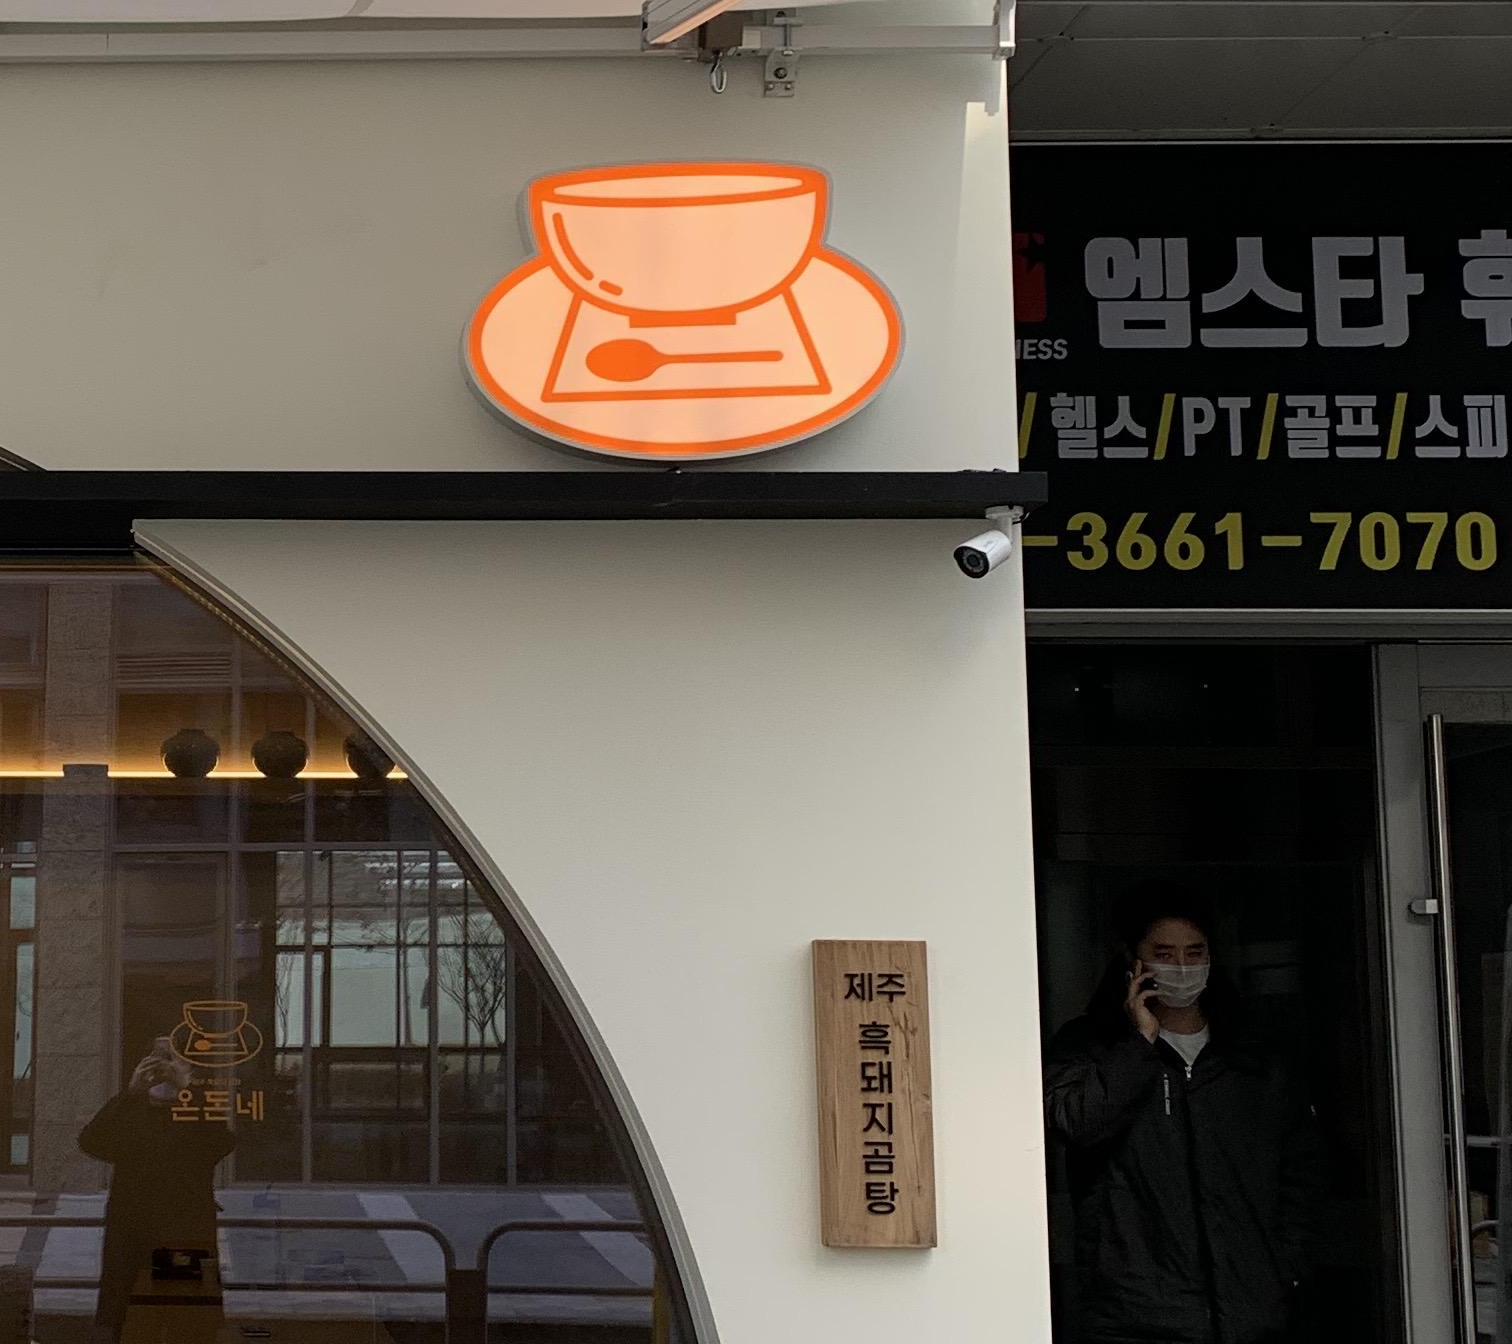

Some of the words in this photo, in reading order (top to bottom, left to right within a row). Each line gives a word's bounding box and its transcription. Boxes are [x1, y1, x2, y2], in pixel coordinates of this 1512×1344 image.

[1084, 236, 1425, 349] 엠스타
[844, 972, 907, 1003] 제주
[170, 1088, 264, 1121] 온돈네
